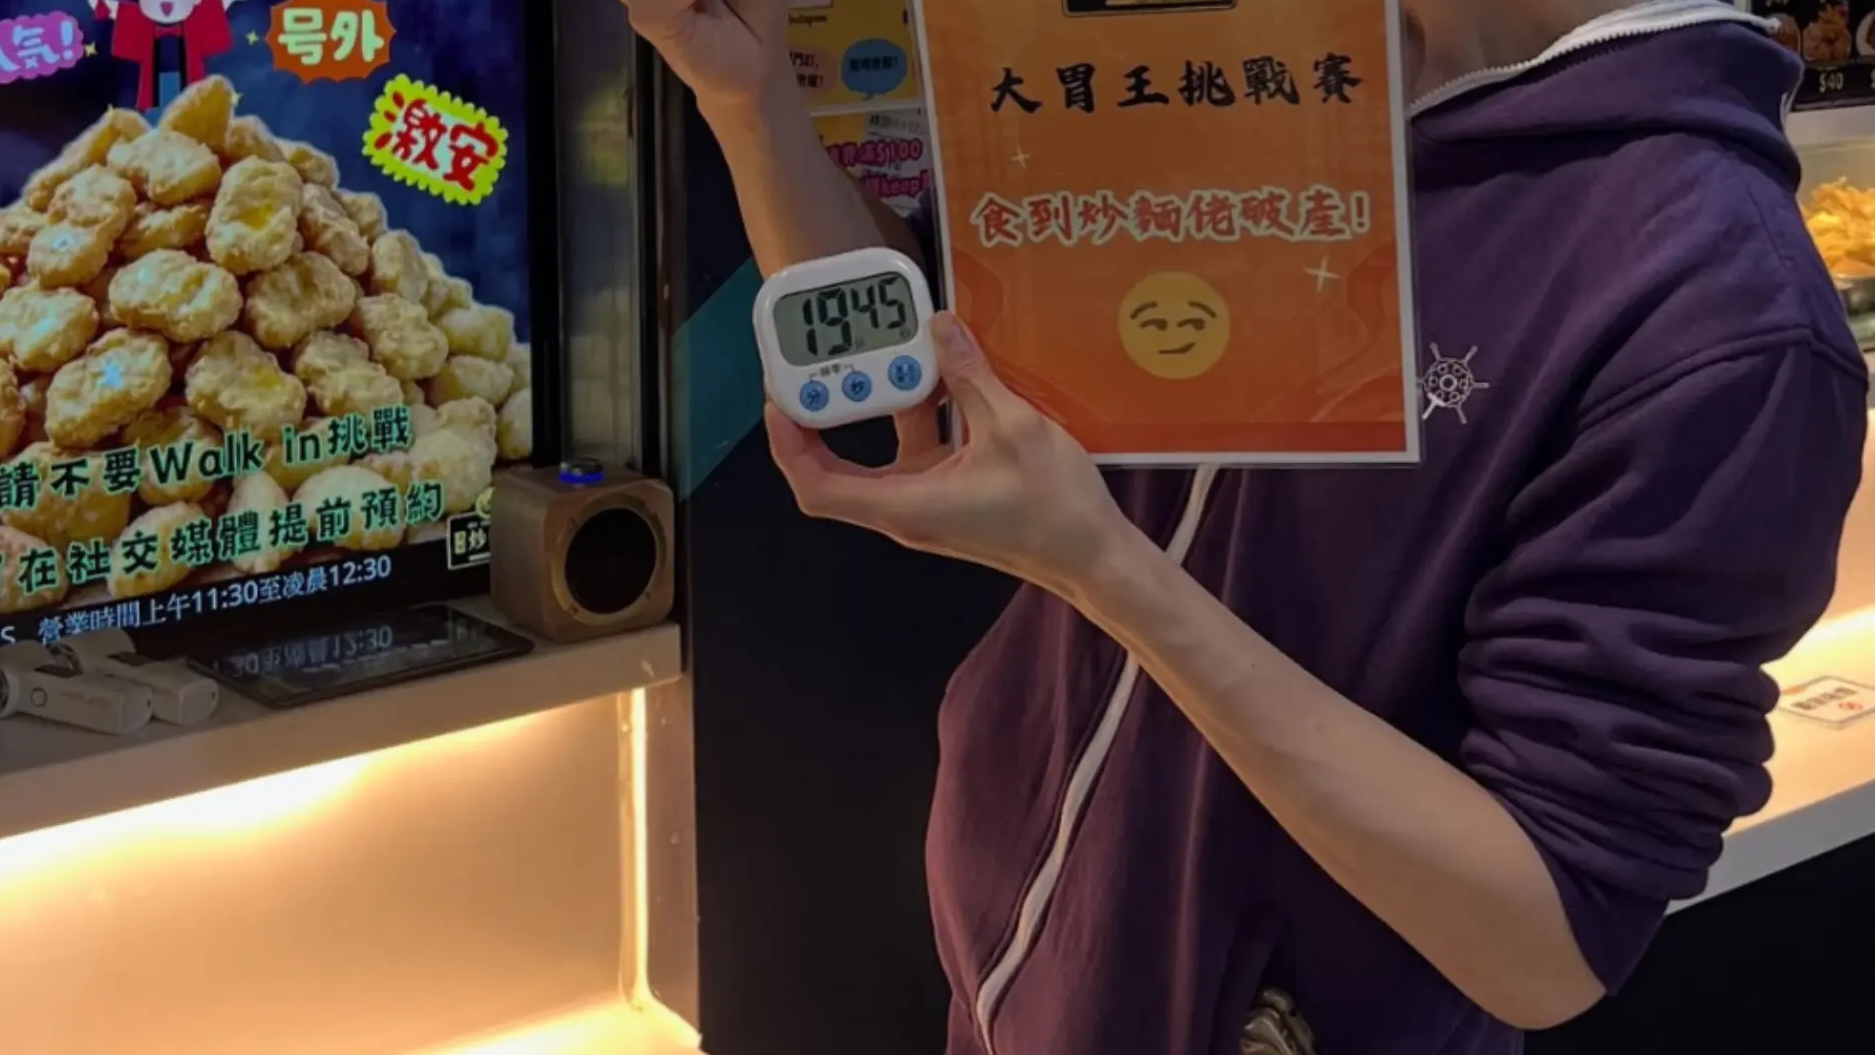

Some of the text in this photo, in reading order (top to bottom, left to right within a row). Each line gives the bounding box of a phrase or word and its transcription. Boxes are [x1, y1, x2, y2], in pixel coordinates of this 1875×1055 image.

[277, 6, 385, 65] 号外
[989, 52, 1365, 115] 大胃王挑戰賽
[374, 89, 506, 192] 激安
